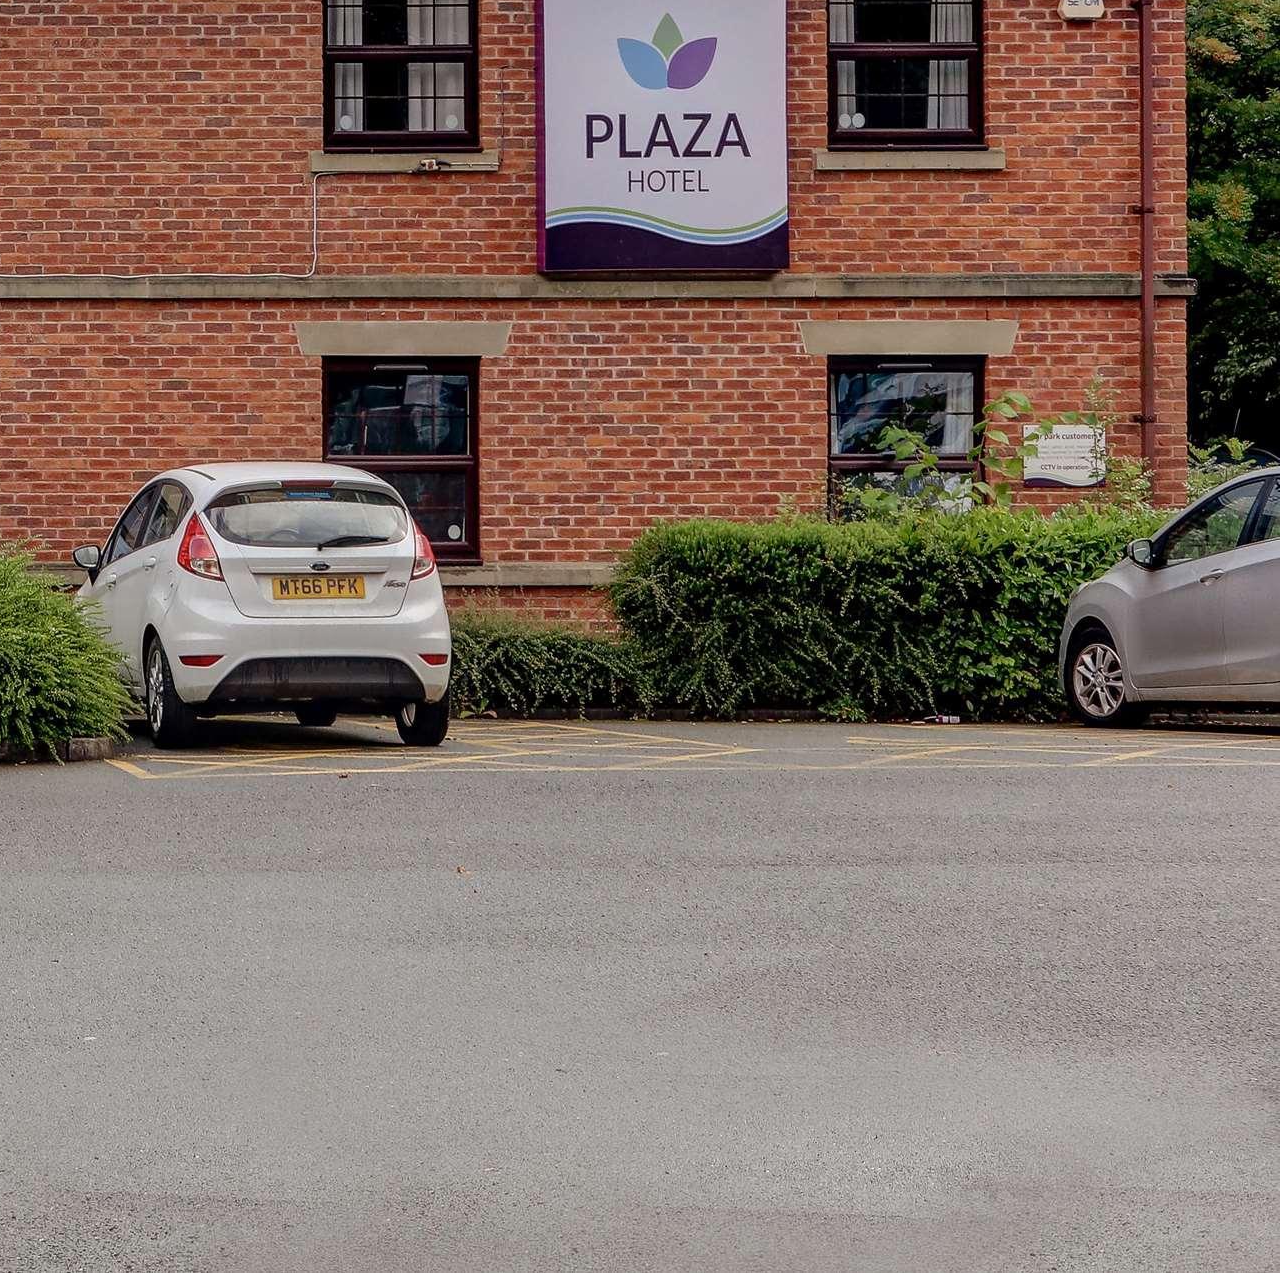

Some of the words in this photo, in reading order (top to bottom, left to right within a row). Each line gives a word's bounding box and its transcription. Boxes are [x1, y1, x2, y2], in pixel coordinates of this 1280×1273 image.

[585, 113, 752, 159] PLAZA
[628, 170, 710, 193] HOTEL
[279, 578, 321, 595] MT66
[327, 578, 359, 594] PFK
